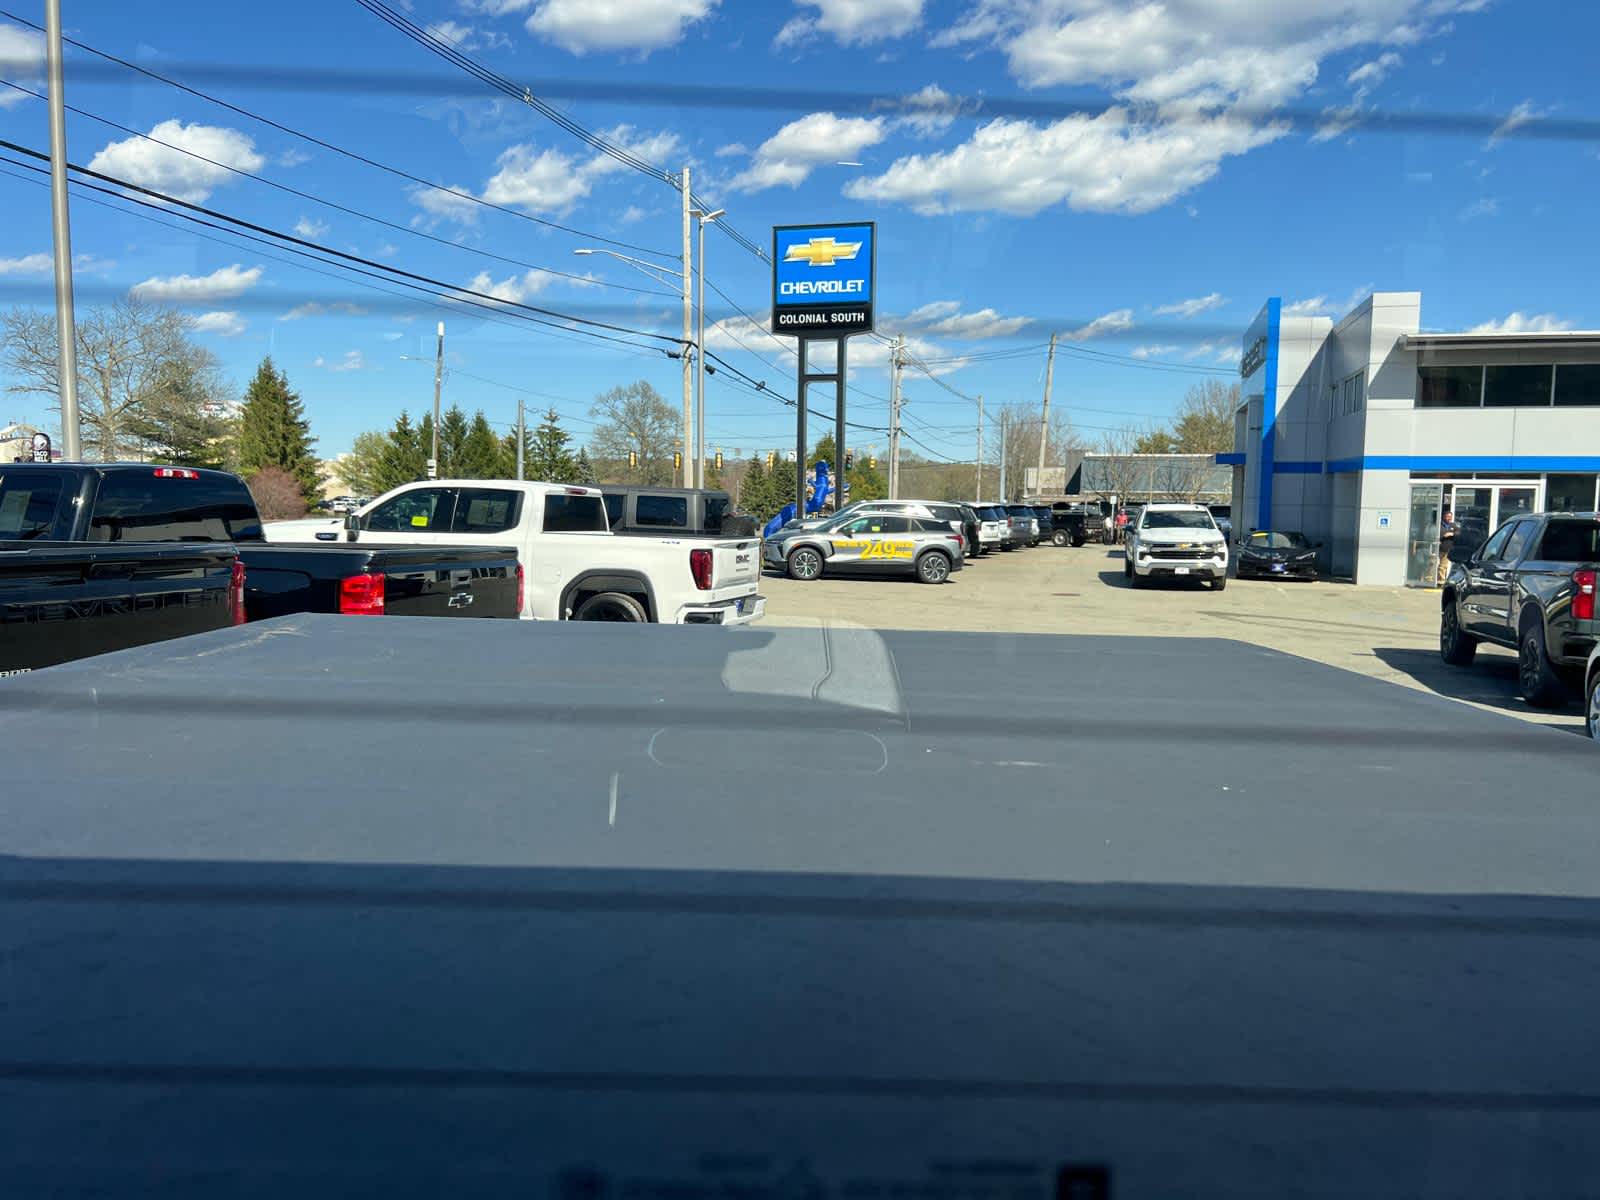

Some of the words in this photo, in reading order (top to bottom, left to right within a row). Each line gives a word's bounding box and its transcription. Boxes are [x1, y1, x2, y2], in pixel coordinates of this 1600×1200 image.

[780, 279, 865, 294] CHEVROLET
[779, 313, 828, 325] COLONIAL
[831, 312, 865, 323] SOUTH
[860, 541, 897, 560] 249
